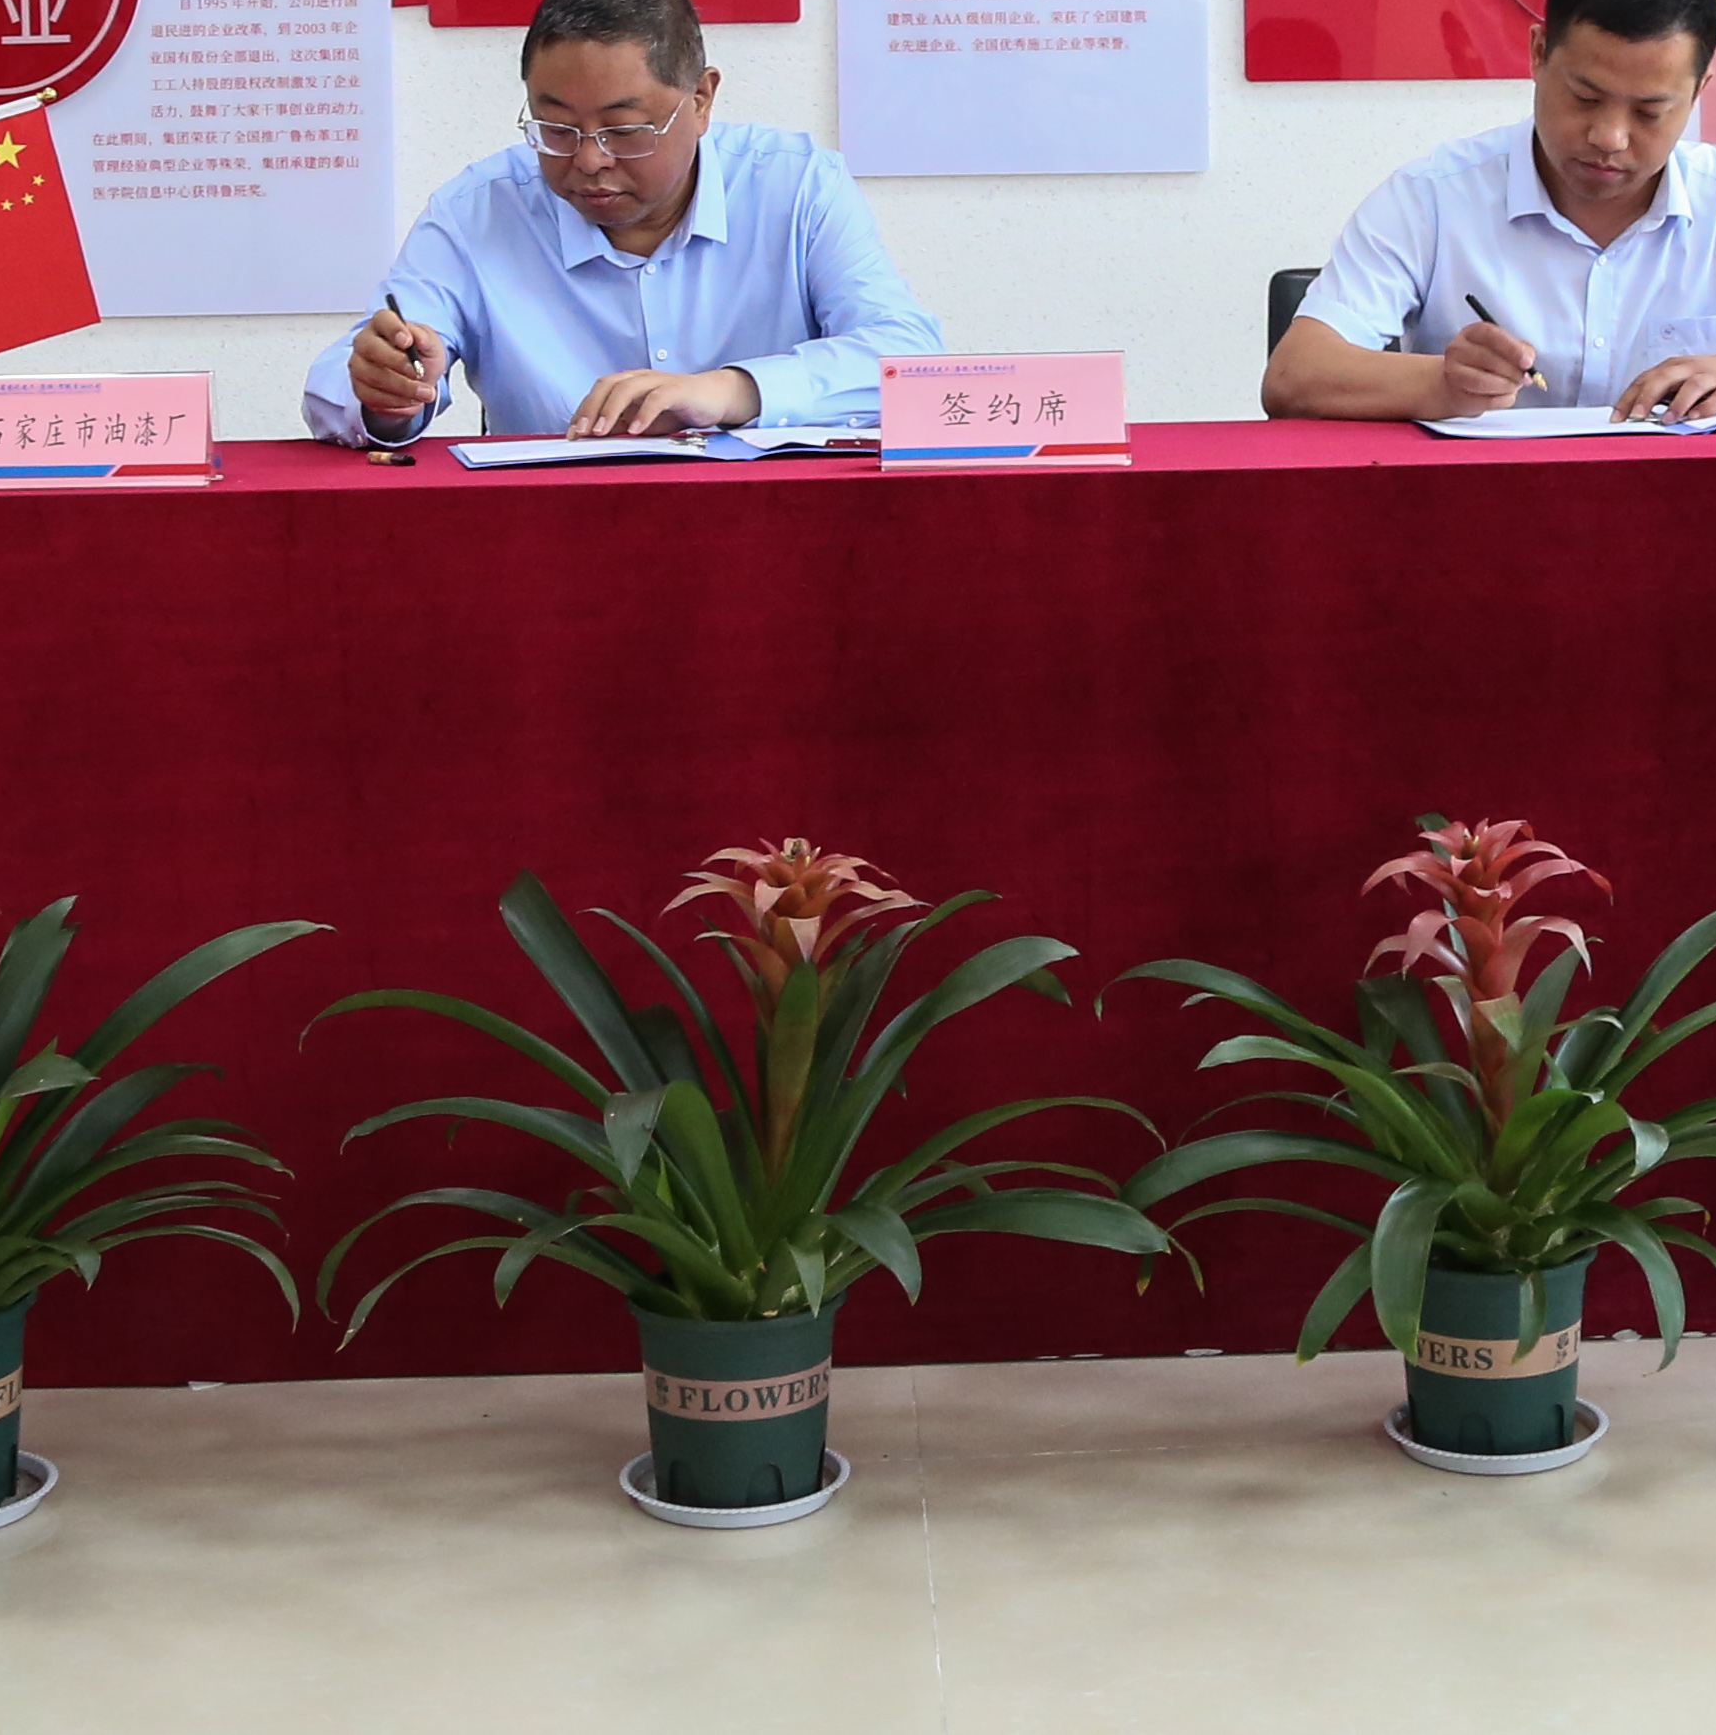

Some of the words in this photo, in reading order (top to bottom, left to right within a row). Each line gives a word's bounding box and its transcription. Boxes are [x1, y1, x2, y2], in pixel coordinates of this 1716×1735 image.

[940, 390, 1068, 427] 签约席
[679, 1373, 829, 1412] FLOWERS
